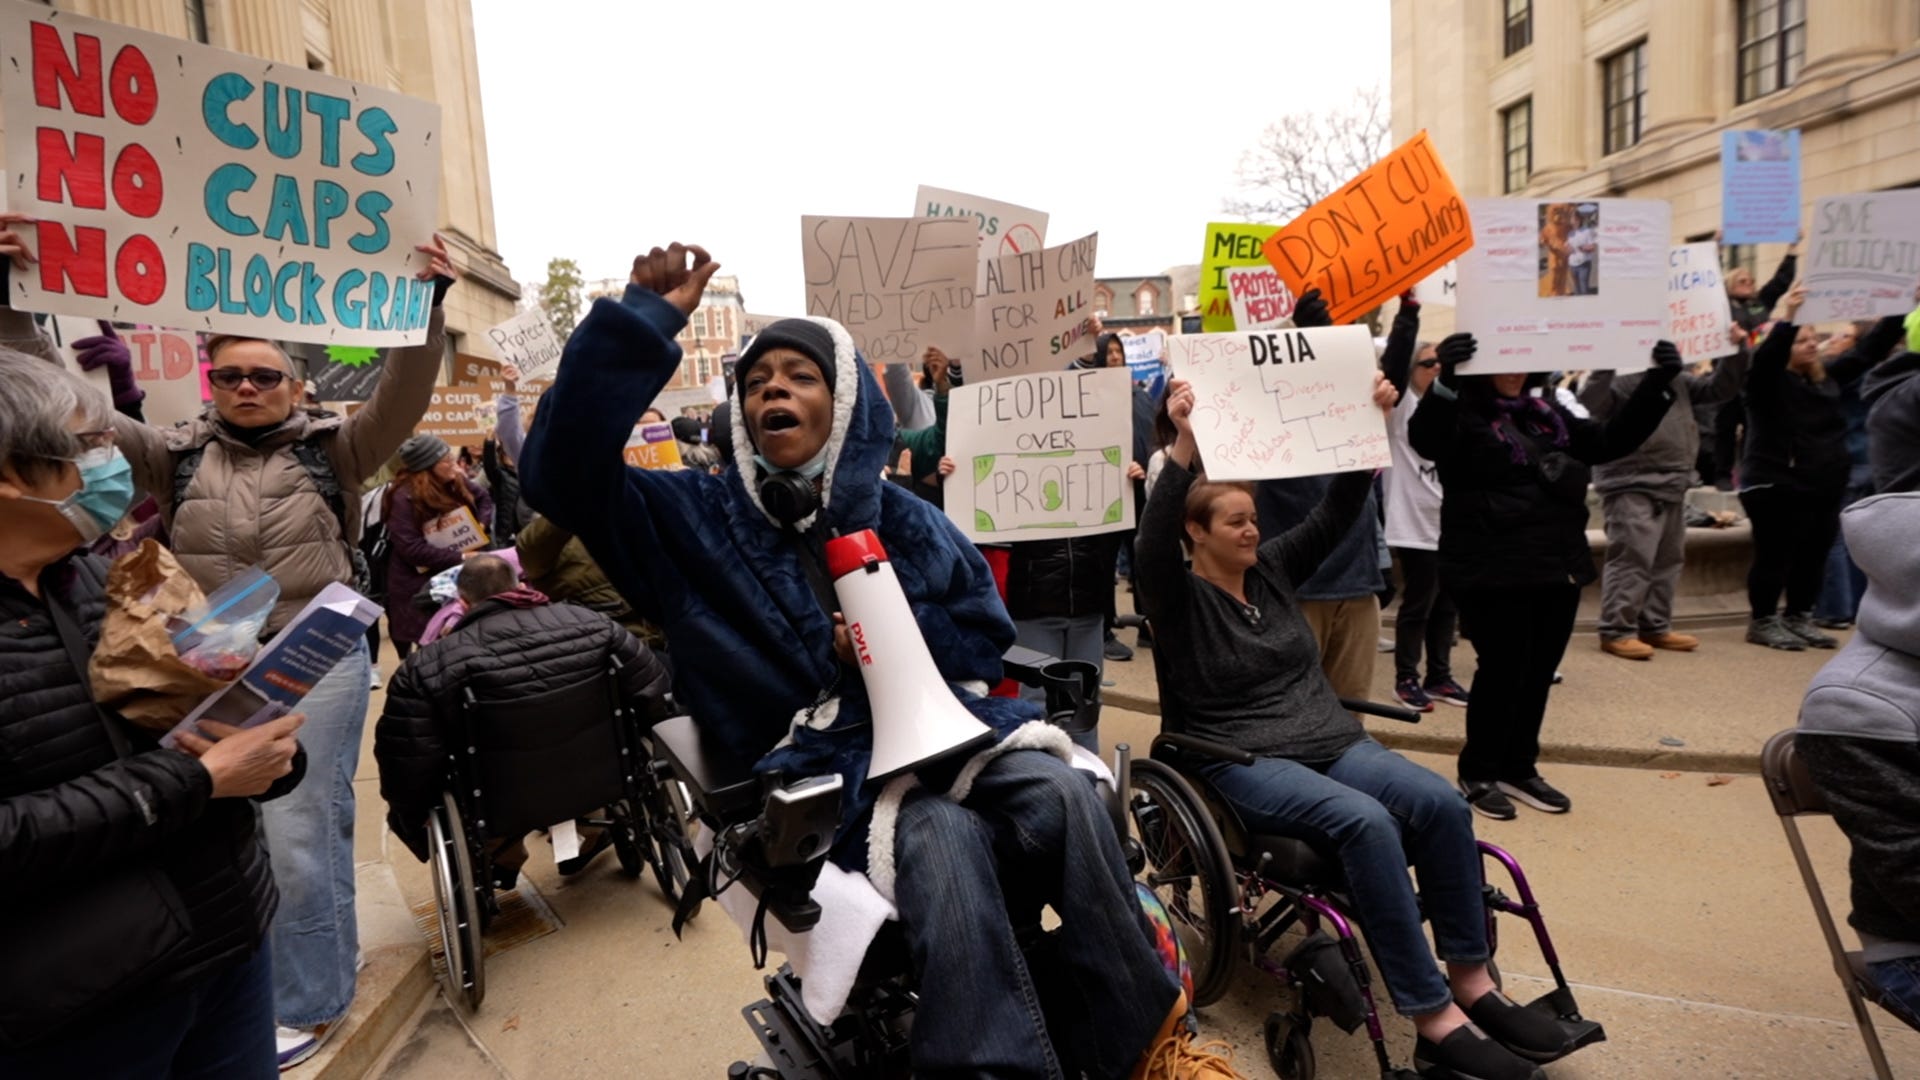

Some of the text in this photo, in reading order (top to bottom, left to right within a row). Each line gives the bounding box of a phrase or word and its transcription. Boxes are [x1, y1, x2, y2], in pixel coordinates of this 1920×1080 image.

[30, 21, 398, 176] NO CUTS
[36, 126, 393, 254] NO CAPS
[1387, 137, 1442, 204] CUT
[1374, 196, 1465, 275] Funding
[1820, 200, 1874, 235] SAVE
[36, 219, 166, 306] NO
[185, 242, 327, 326] BLOCK
[805, 219, 972, 293] SAVE
[976, 235, 1097, 297] ALTH CARE
[809, 286, 975, 332] MEDICAID
[992, 289, 1087, 332] FOR ALL
[488, 315, 546, 352] Protect
[982, 338, 1034, 371] NOT
[1248, 331, 1316, 366] DEIA
[445, 393, 481, 405] CUTS
[978, 371, 1099, 425] PEOPLE
[626, 446, 660, 466] AVE
[1016, 430, 1076, 450] OVER
[994, 462, 1109, 513] PROFIT
[850, 621, 873, 667] PYLE
